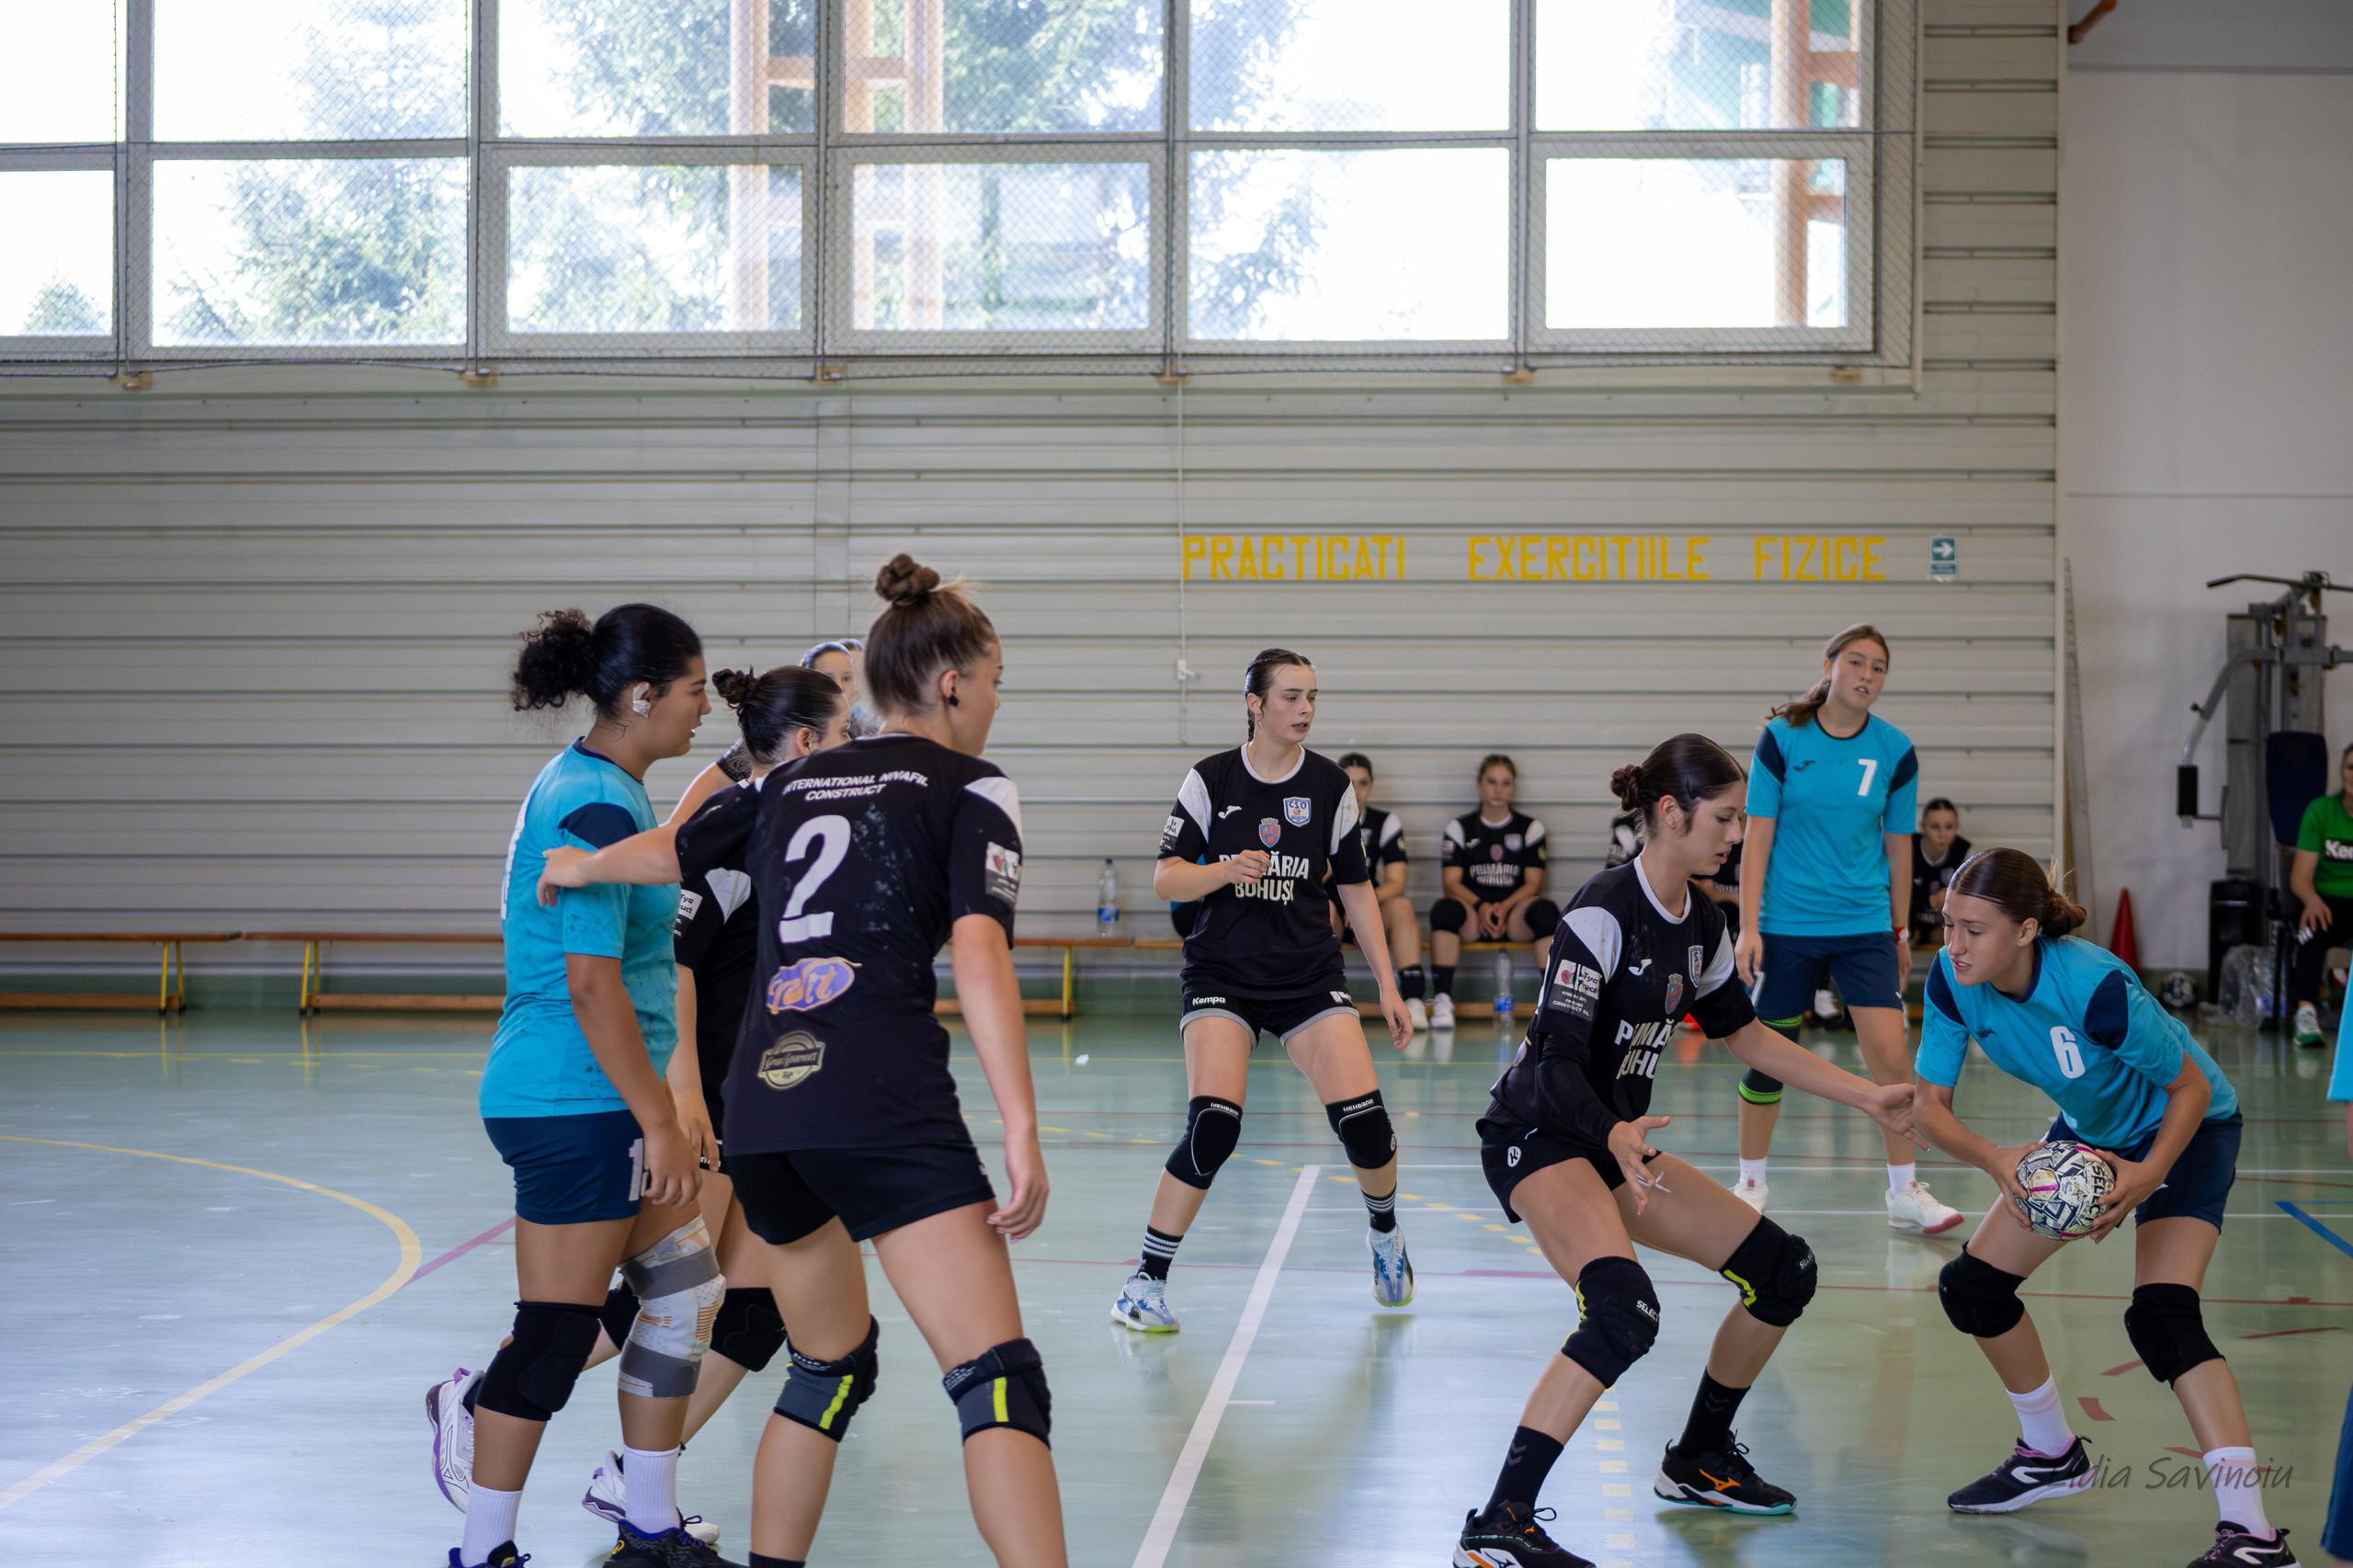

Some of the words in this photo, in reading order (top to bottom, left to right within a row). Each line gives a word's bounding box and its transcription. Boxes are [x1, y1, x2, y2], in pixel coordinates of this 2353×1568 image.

[1183, 536, 1405, 580] PRACTICATI
[1468, 536, 1711, 580] EXERCITIILE
[1755, 536, 1887, 581] FIZICE
[804, 784, 887, 801] CONSTRUCT
[1858, 758, 1878, 797] 7
[779, 814, 851, 944] 2
[1192, 995, 1226, 1006] Kempa
[2050, 1025, 2086, 1079] 6
